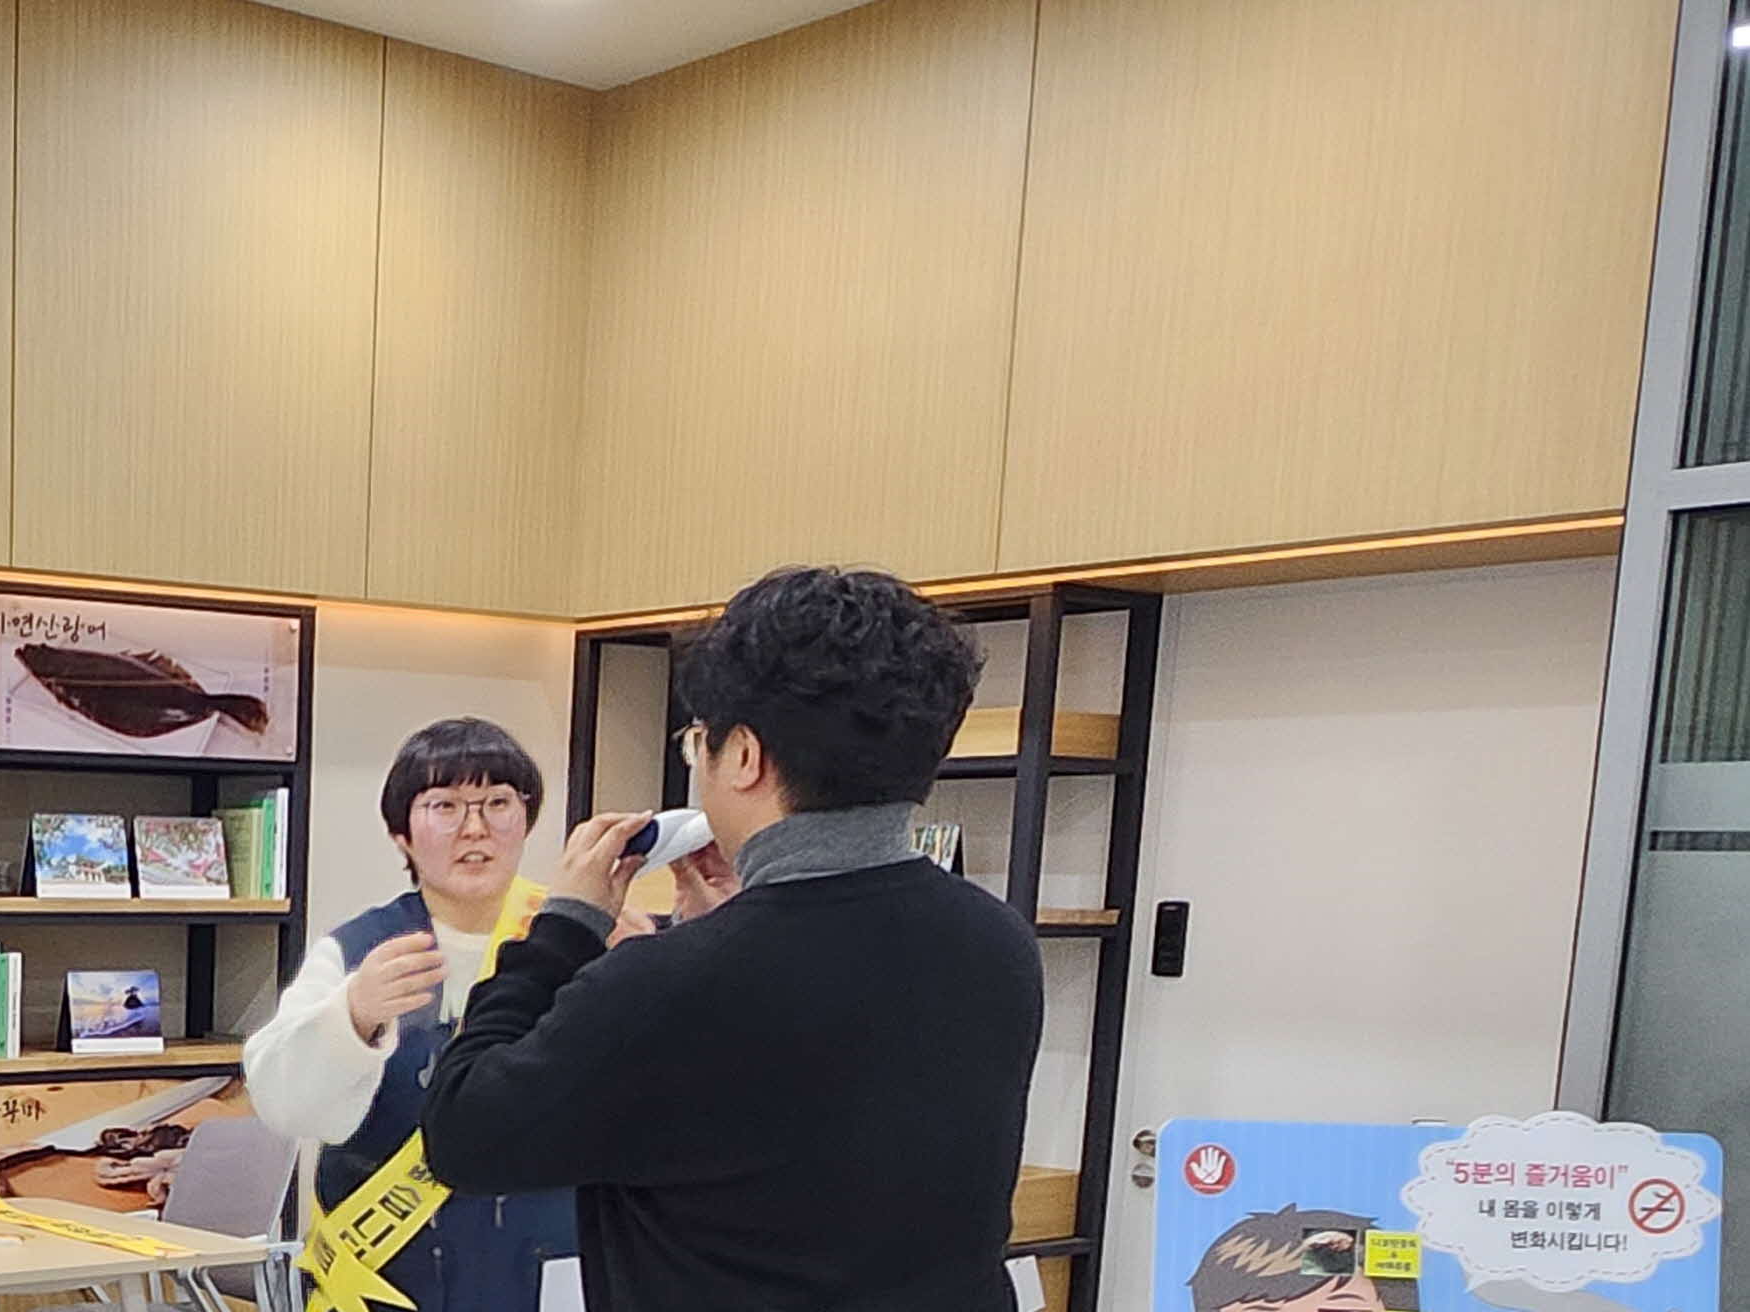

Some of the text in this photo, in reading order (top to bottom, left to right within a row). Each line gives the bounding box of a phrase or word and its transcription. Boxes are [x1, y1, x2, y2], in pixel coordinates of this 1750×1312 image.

[1478, 1199, 1602, 1221] 내 몸을 이렇게
[1510, 1230, 1629, 1252] 변화시킵니다!
